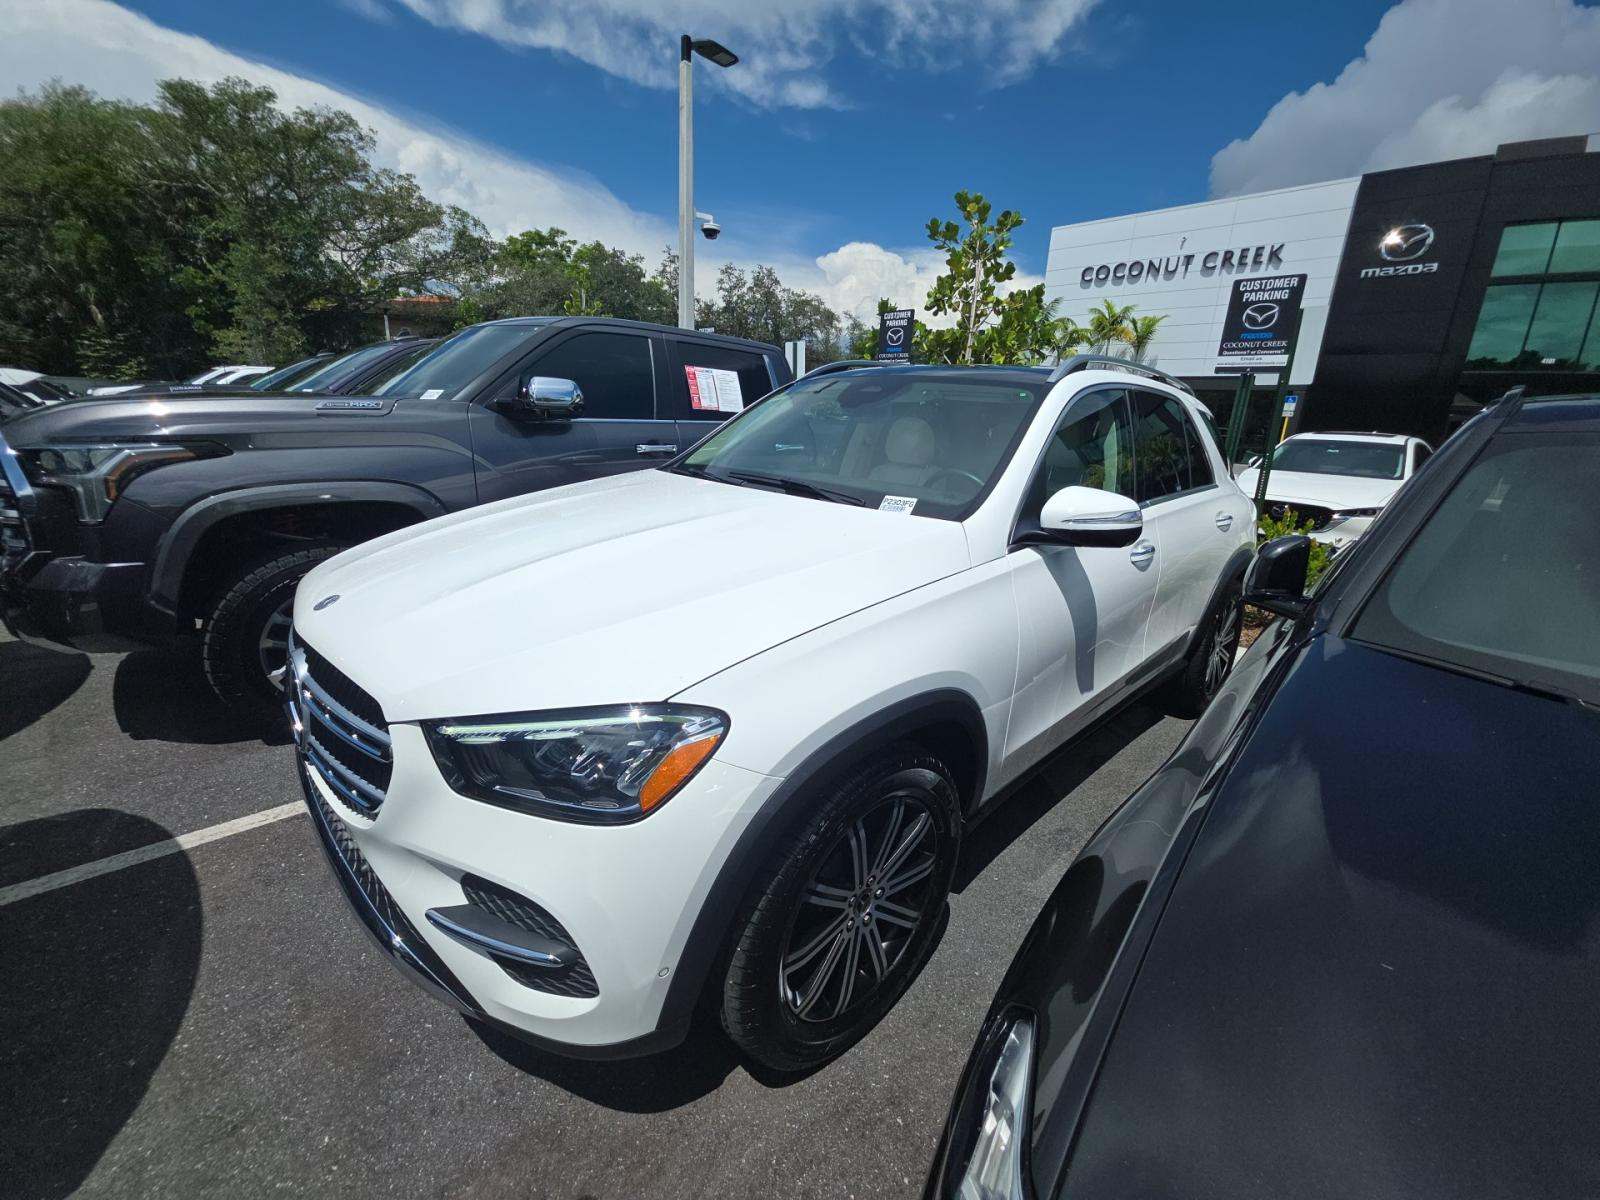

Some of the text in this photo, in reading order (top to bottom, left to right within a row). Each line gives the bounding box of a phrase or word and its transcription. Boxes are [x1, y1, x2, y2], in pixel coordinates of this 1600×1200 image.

[1081, 243, 1286, 282] COCONUT CREEK
[1360, 262, 1439, 279] mazda
[1239, 277, 1299, 291] CUSTOMER
[1242, 289, 1290, 302] PARKING
[884, 311, 911, 320] CUSTOMER
[886, 319, 908, 327] PARKING
[1222, 341, 1261, 349] COCONUT
